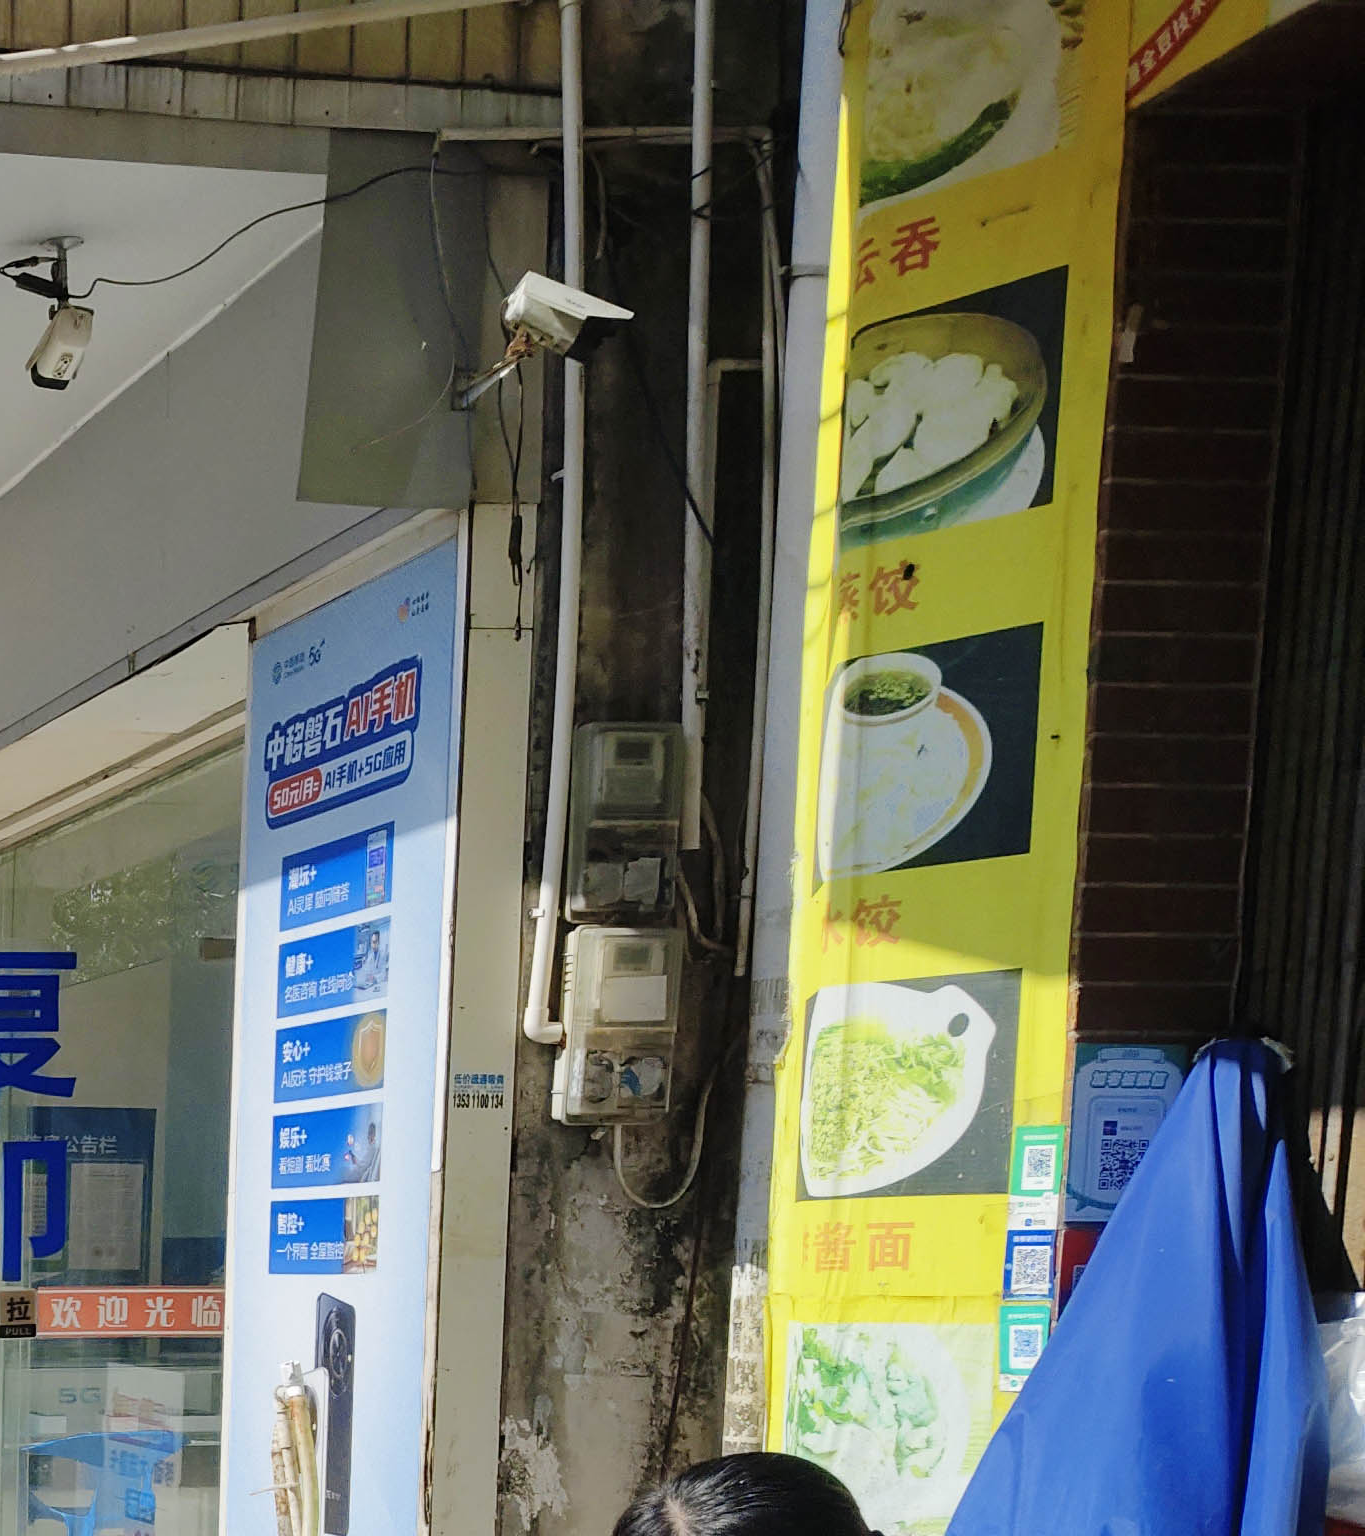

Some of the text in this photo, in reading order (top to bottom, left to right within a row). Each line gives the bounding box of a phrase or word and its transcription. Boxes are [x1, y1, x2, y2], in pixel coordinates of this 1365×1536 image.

[285, 952, 314, 979] 健康+
[281, 1039, 311, 1065] 安心+
[453, 1090, 504, 1109] 1353 1100 134
[279, 1126, 308, 1149] 娱乐+
[802, 1222, 915, 1273] 酱面
[6, 1295, 31, 1322] 拉
[50, 1295, 222, 1328] 欢迎光临
[58, 1387, 102, 1404] 5G
